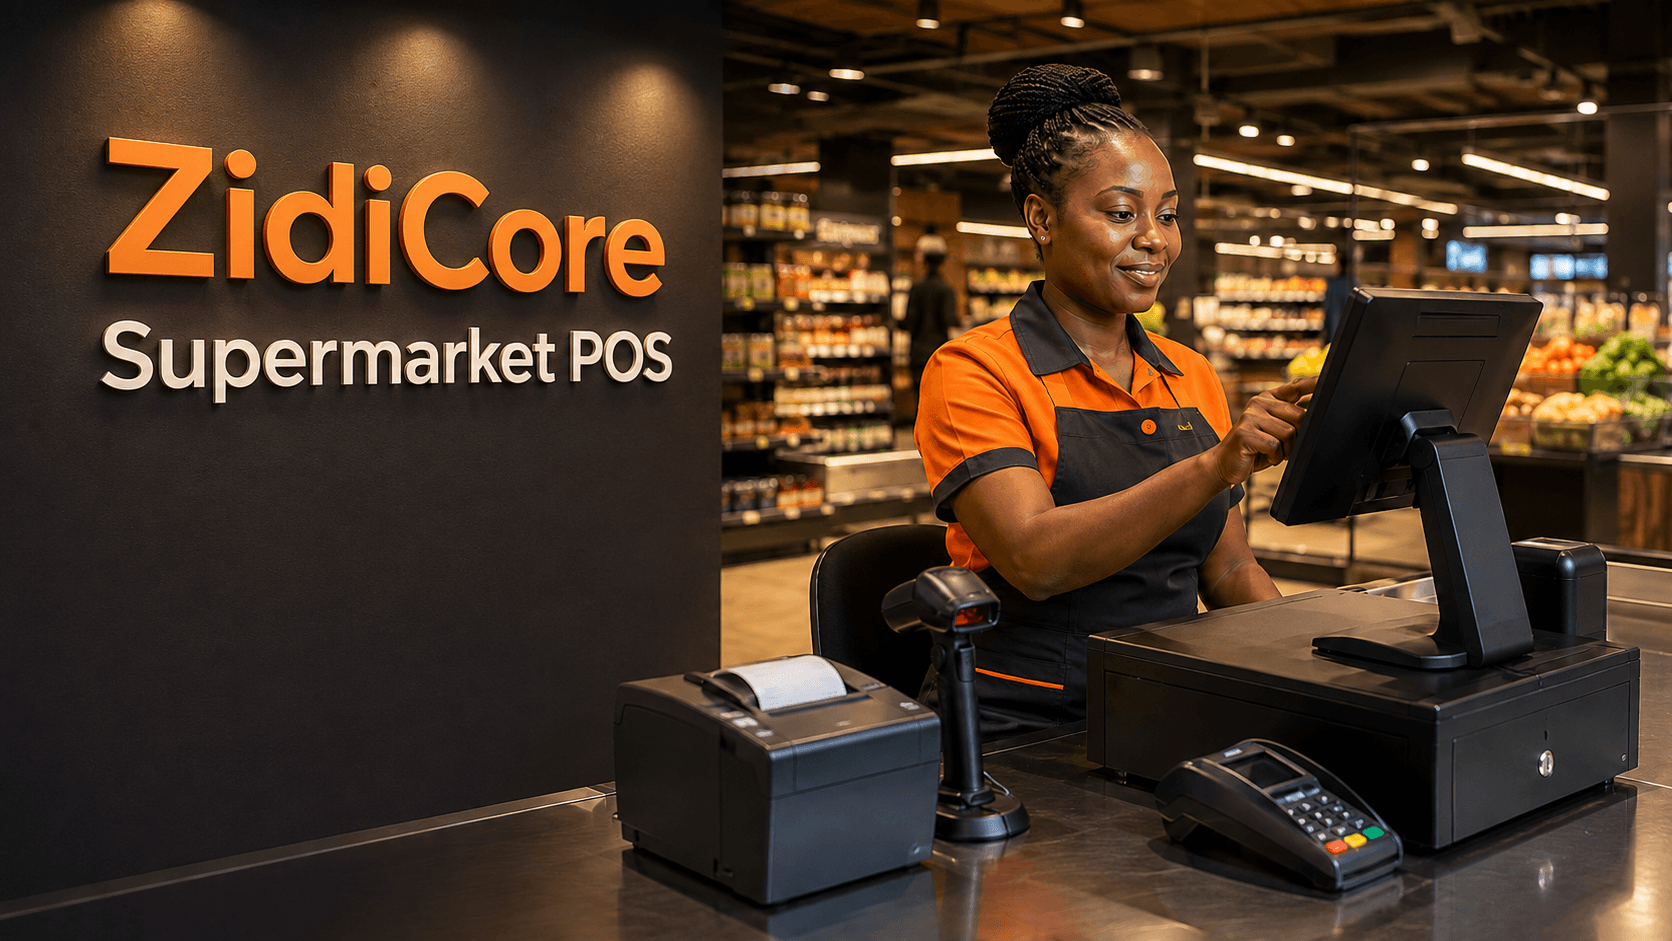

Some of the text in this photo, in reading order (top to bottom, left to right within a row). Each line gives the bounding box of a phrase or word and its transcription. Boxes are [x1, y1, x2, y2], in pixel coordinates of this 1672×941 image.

[106, 137, 665, 297] ZidiCore
[101, 320, 673, 403] Supermarket POS
